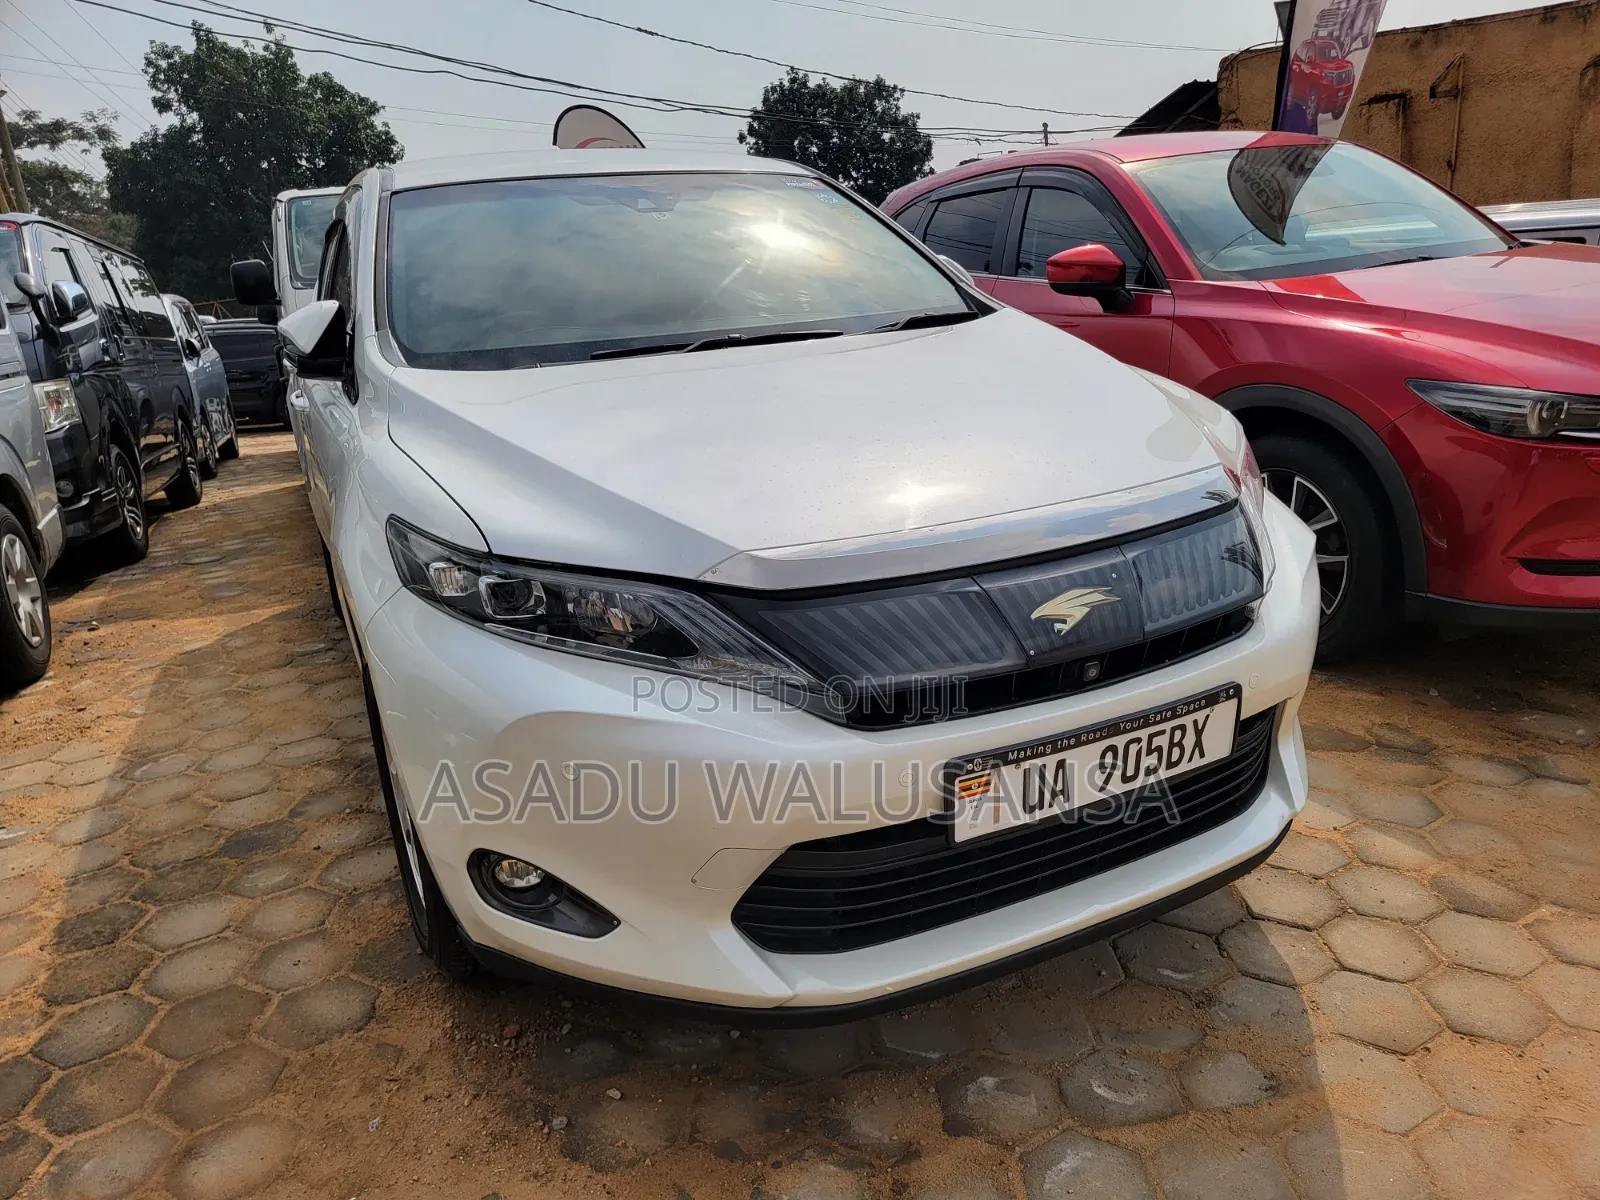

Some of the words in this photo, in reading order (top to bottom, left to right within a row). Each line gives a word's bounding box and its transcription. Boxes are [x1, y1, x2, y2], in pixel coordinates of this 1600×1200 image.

[1007, 744, 1052, 761] Making
[1057, 737, 1076, 749] the
[1080, 726, 1114, 742] Roads
[1119, 718, 1144, 731] Your
[1148, 711, 1172, 723] Safe
[1176, 699, 1206, 715] Space
[1022, 757, 1071, 815] UA
[1098, 713, 1210, 793] 905BX
